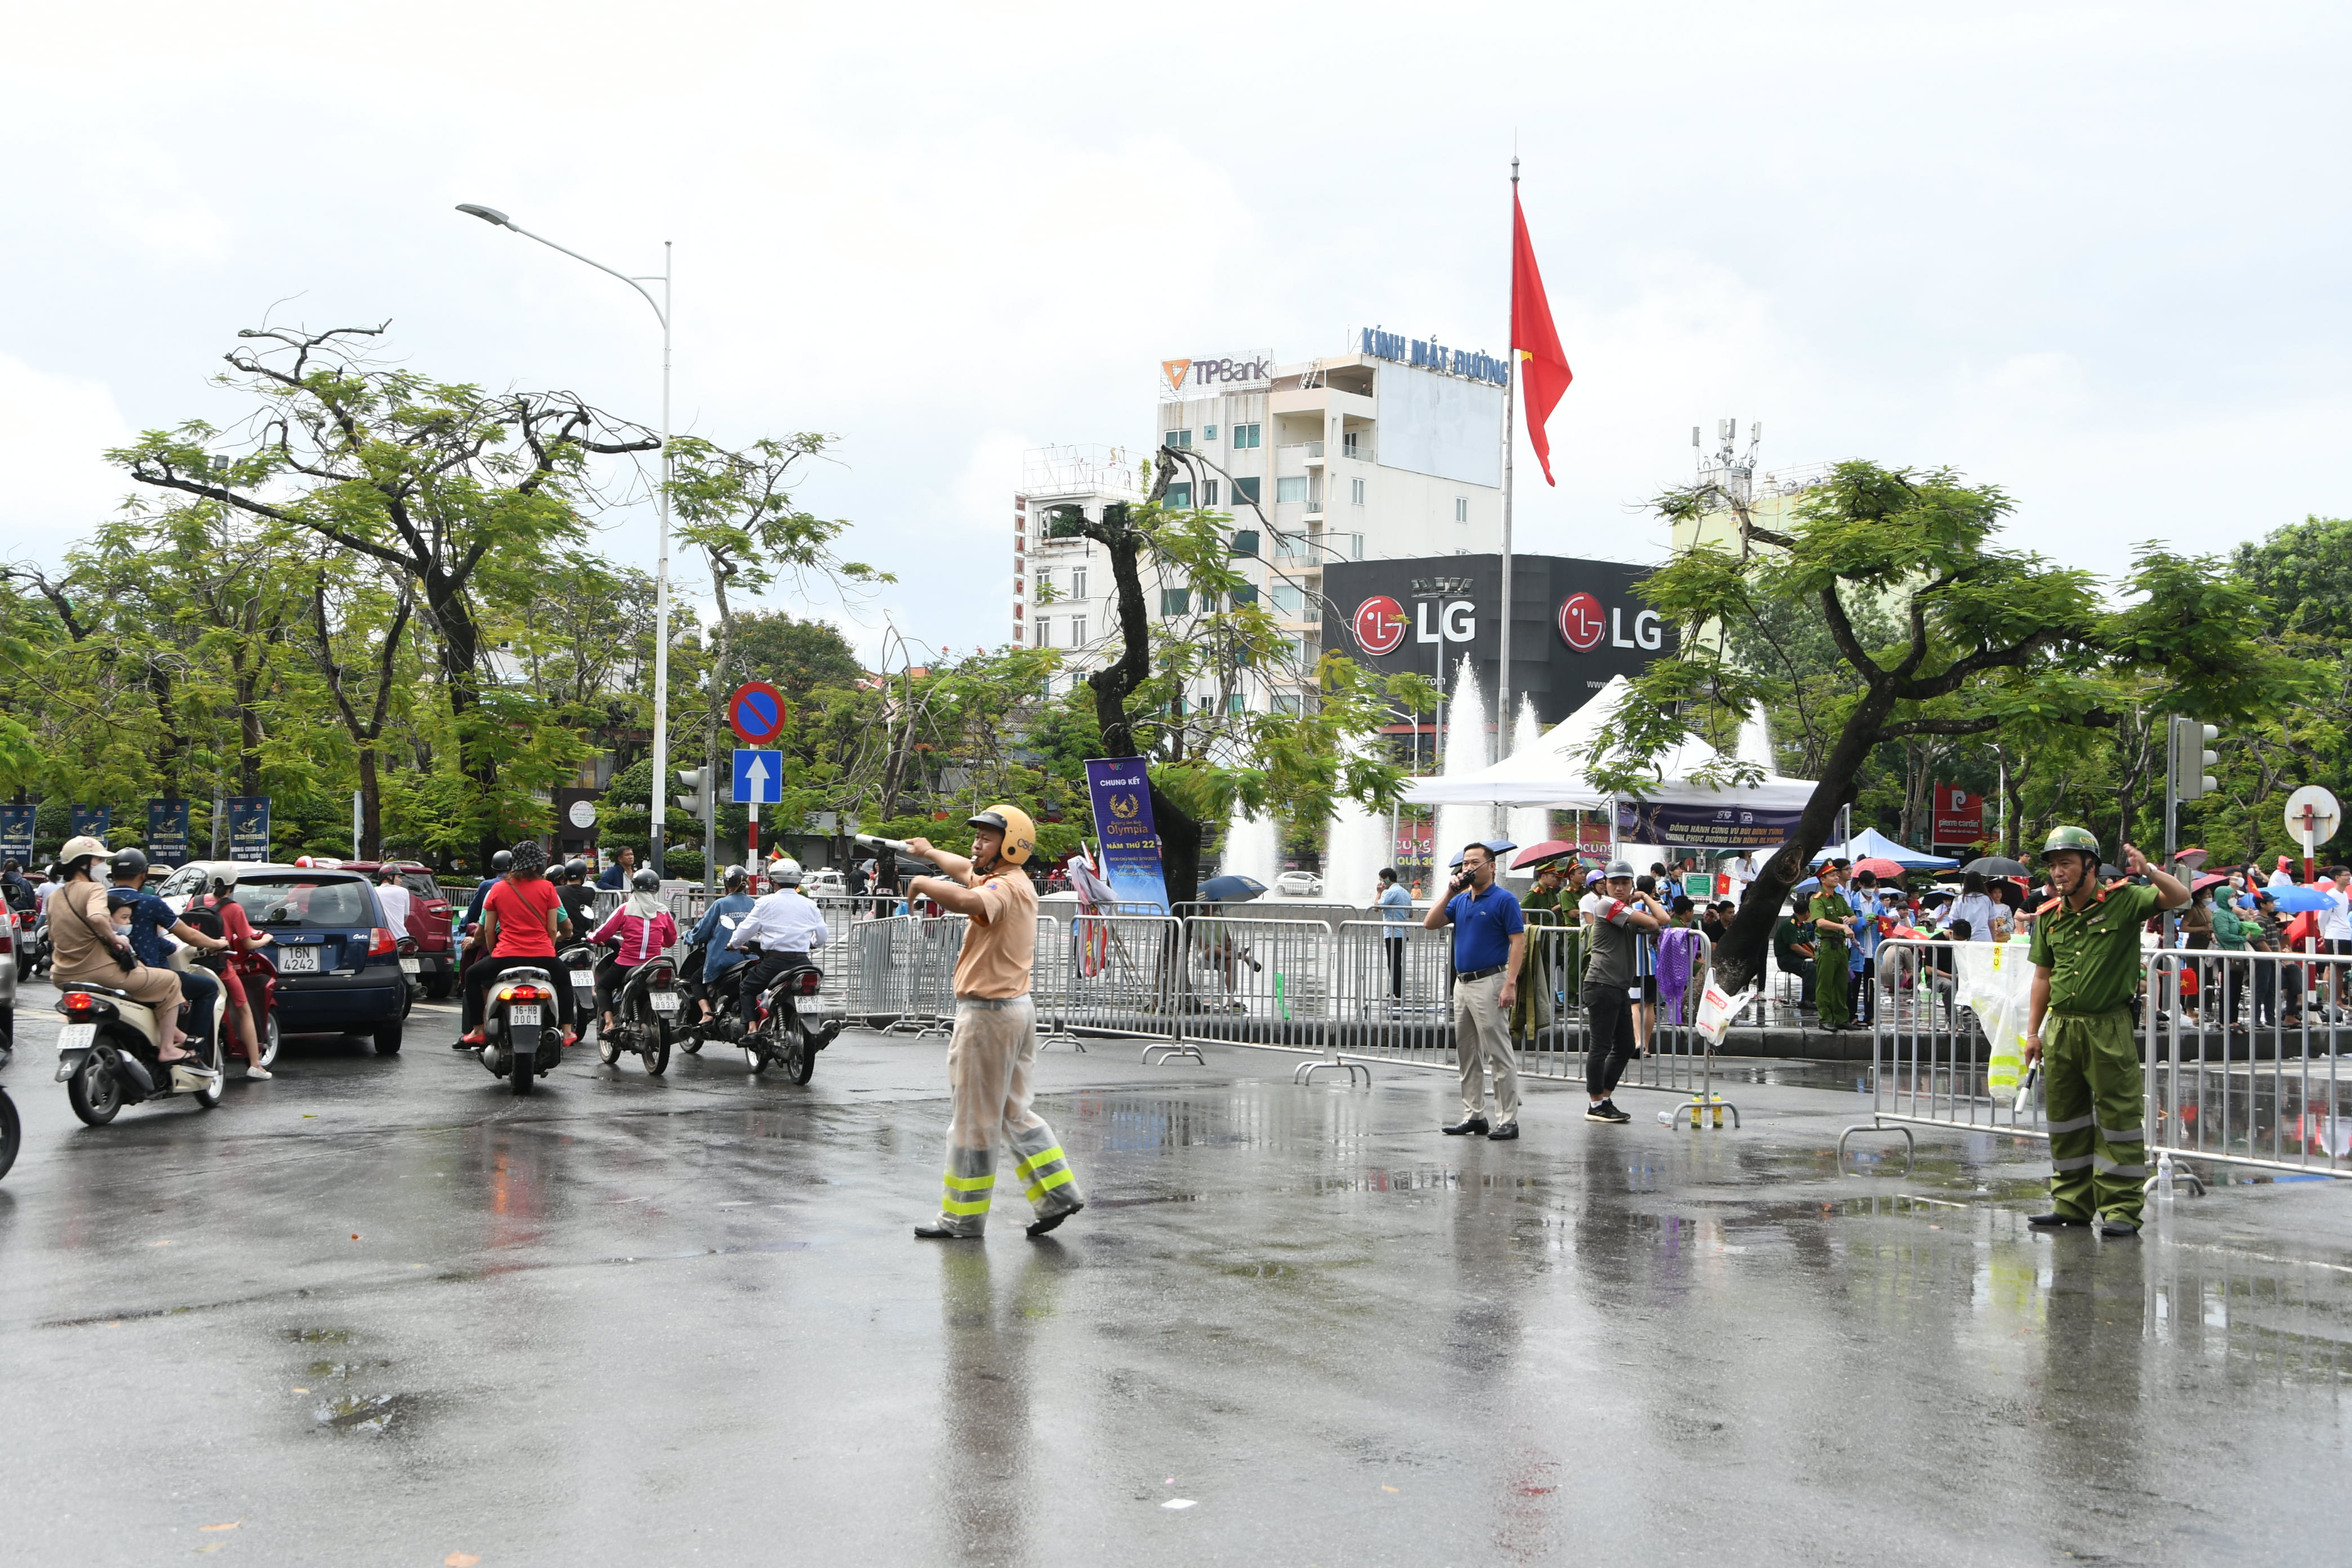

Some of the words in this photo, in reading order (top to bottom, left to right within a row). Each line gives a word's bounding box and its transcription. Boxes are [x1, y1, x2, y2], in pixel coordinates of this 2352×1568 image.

[1362, 324, 1405, 359] KÍNH
[1193, 356, 1270, 385] TPBank
[1417, 601, 1476, 643] LG
[1612, 608, 1661, 650] LG
[1128, 776, 1141, 785] KẾT
[1939, 819, 1957, 828] pierre
[1107, 825, 1148, 836] Olympia
[289, 947, 310, 959] 16N
[284, 959, 314, 970] 4242
[515, 1006, 537, 1014] 16-H8
[514, 1015, 537, 1024] 0001
